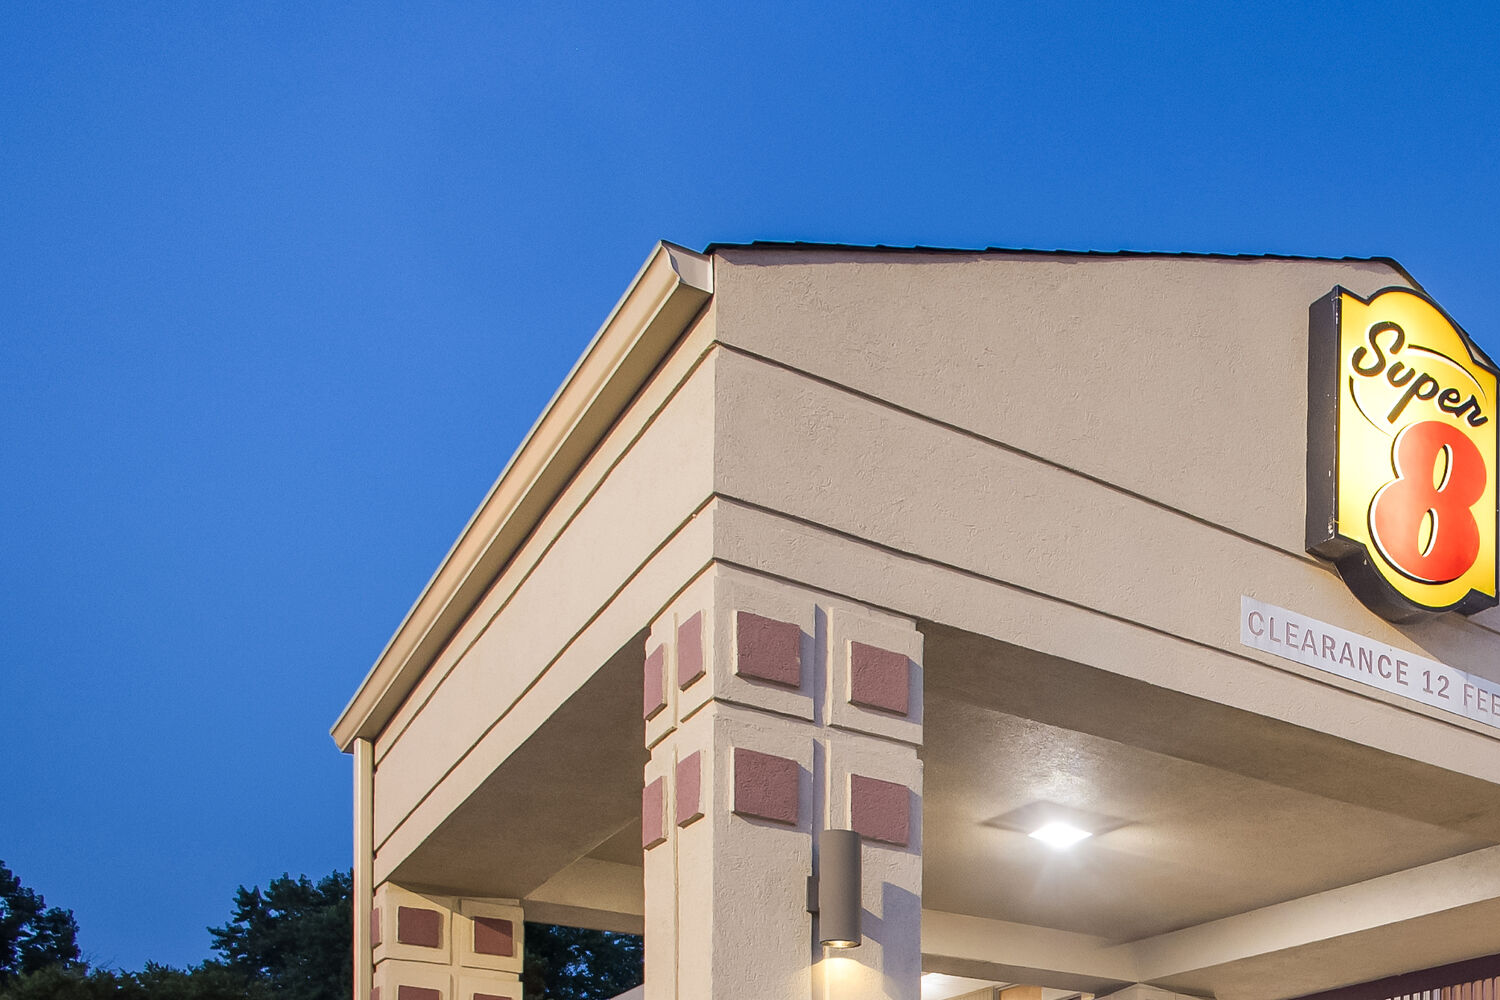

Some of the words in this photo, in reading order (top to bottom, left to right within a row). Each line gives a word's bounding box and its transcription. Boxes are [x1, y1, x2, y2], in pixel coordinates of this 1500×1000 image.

[1351, 321, 1488, 427] Super
[1367, 420, 1487, 585] 8
[1248, 611, 1409, 686] CLEARANCE
[1422, 670, 1450, 700] 12
